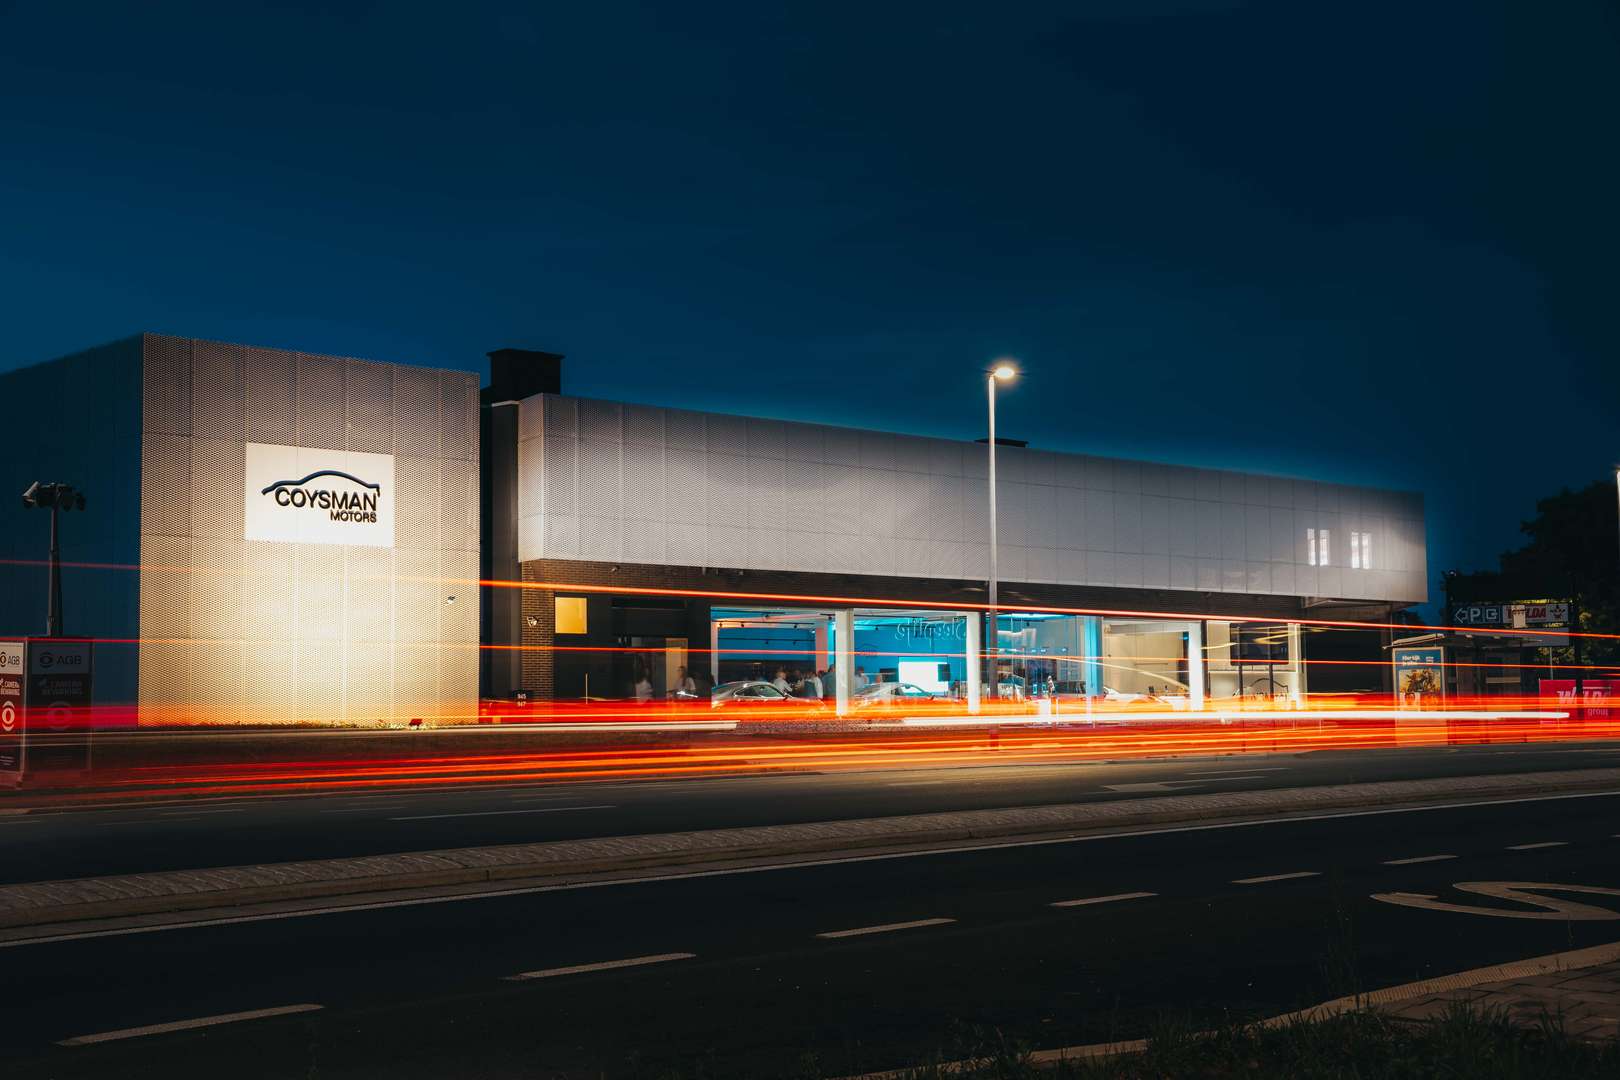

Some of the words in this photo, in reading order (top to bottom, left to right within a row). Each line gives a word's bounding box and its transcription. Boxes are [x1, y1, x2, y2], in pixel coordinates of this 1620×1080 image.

[275, 487, 377, 511] COYSMAN
[330, 510, 377, 523] MOTORS
[56, 656, 82, 664] AGB
